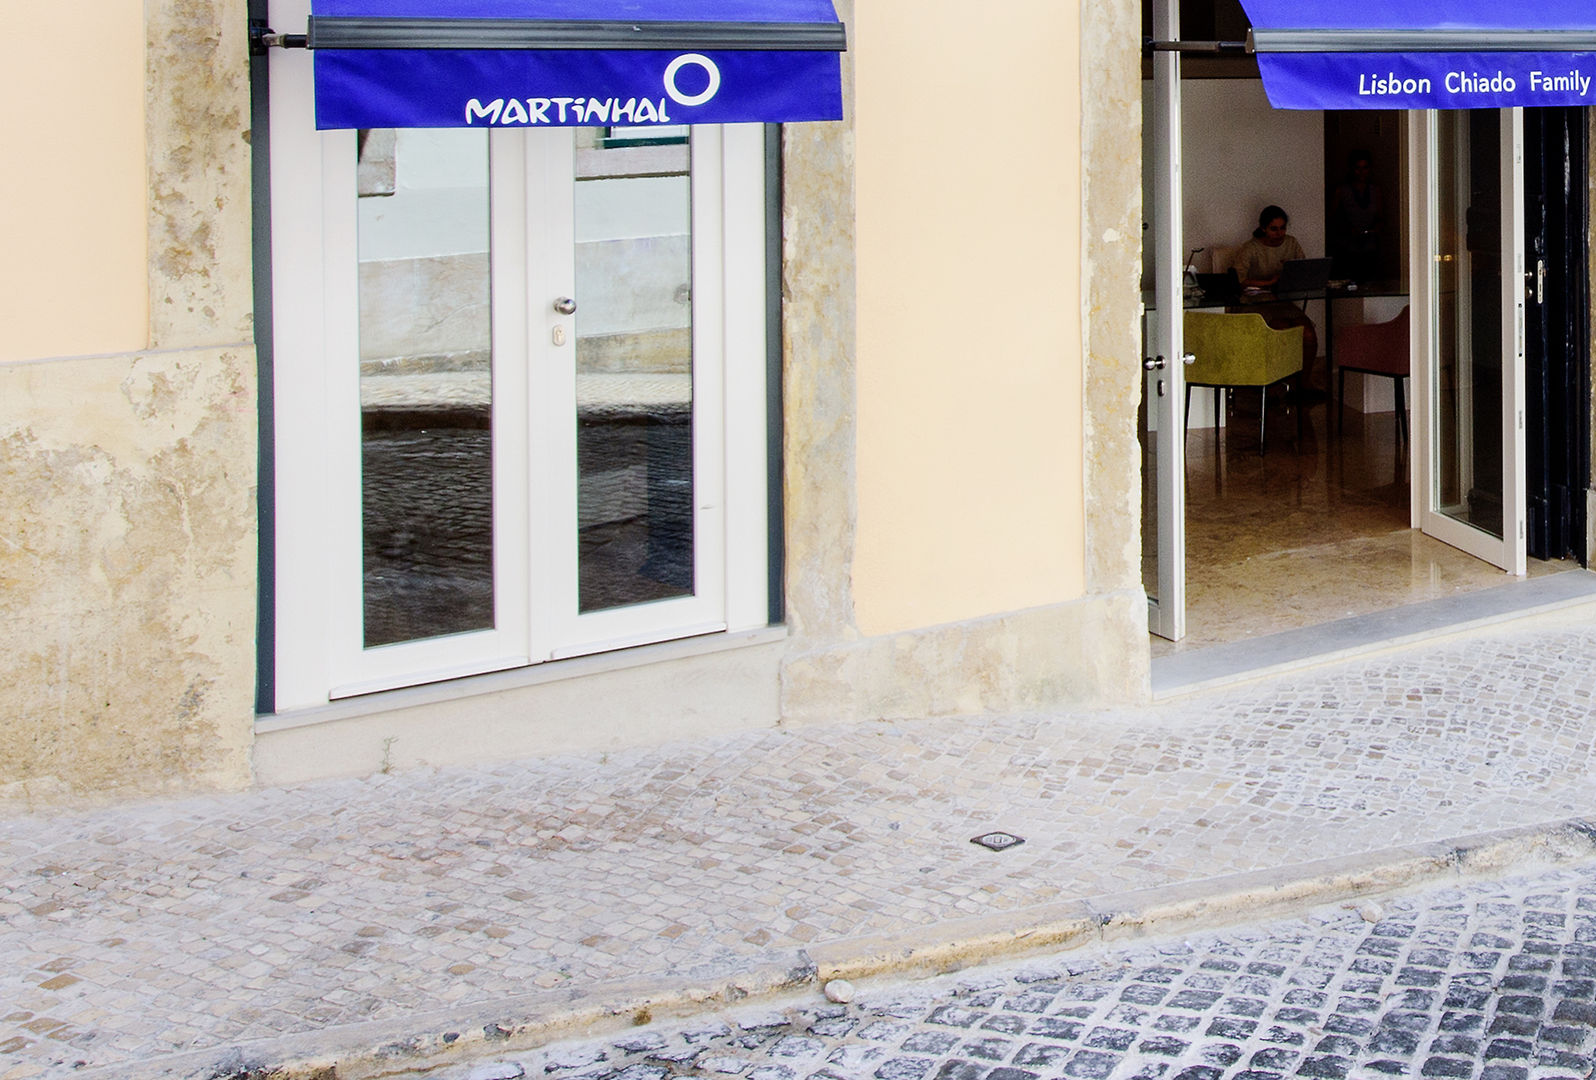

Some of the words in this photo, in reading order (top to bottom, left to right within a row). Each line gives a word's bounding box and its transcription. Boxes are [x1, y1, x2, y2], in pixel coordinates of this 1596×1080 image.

[1358, 72, 1432, 96] Lisbon
[1444, 70, 1517, 94] Chiado
[1529, 69, 1592, 97] Family
